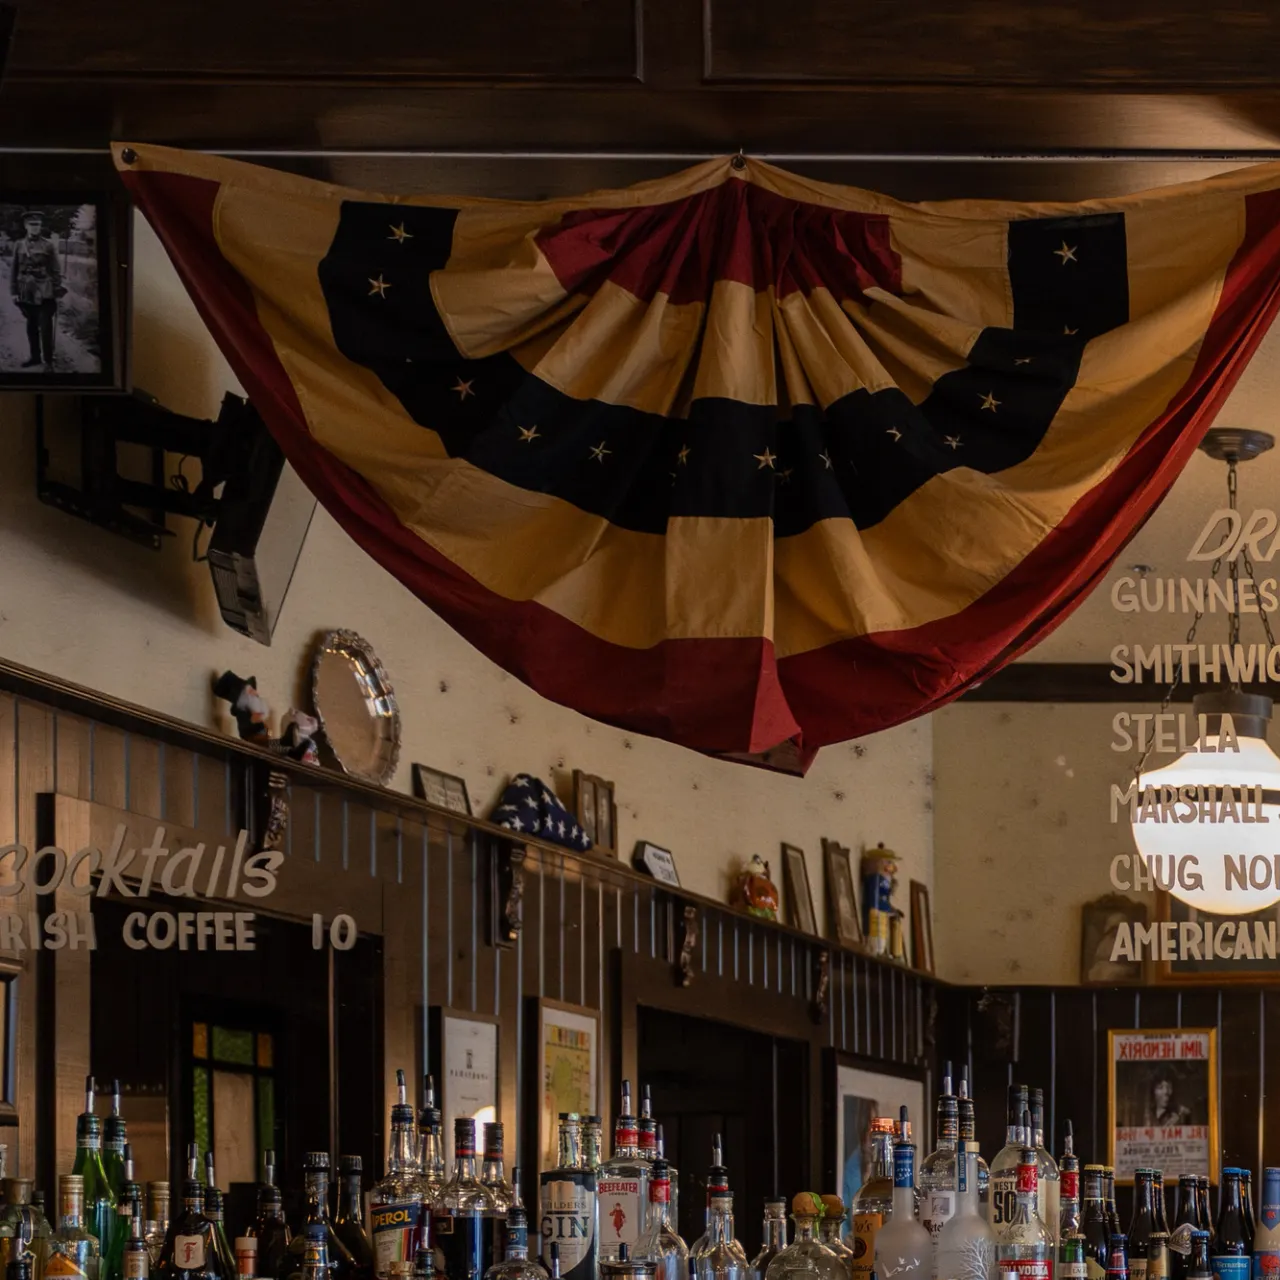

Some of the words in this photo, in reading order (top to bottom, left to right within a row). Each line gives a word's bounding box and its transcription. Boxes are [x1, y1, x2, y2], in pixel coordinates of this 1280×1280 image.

[1111, 712, 1240, 754] STELLA
[1111, 782, 1269, 823] MARSHALL
[1111, 854, 1203, 891] CHUG
[123, 912, 256, 951] COFFEE
[312, 913, 358, 951] 10
[1111, 921, 1277, 962] AMERICAN
[598, 1182, 638, 1194] BEEFEATER
[541, 1216, 590, 1238] GIN
[1018, 1264, 1049, 1276] VODKA
